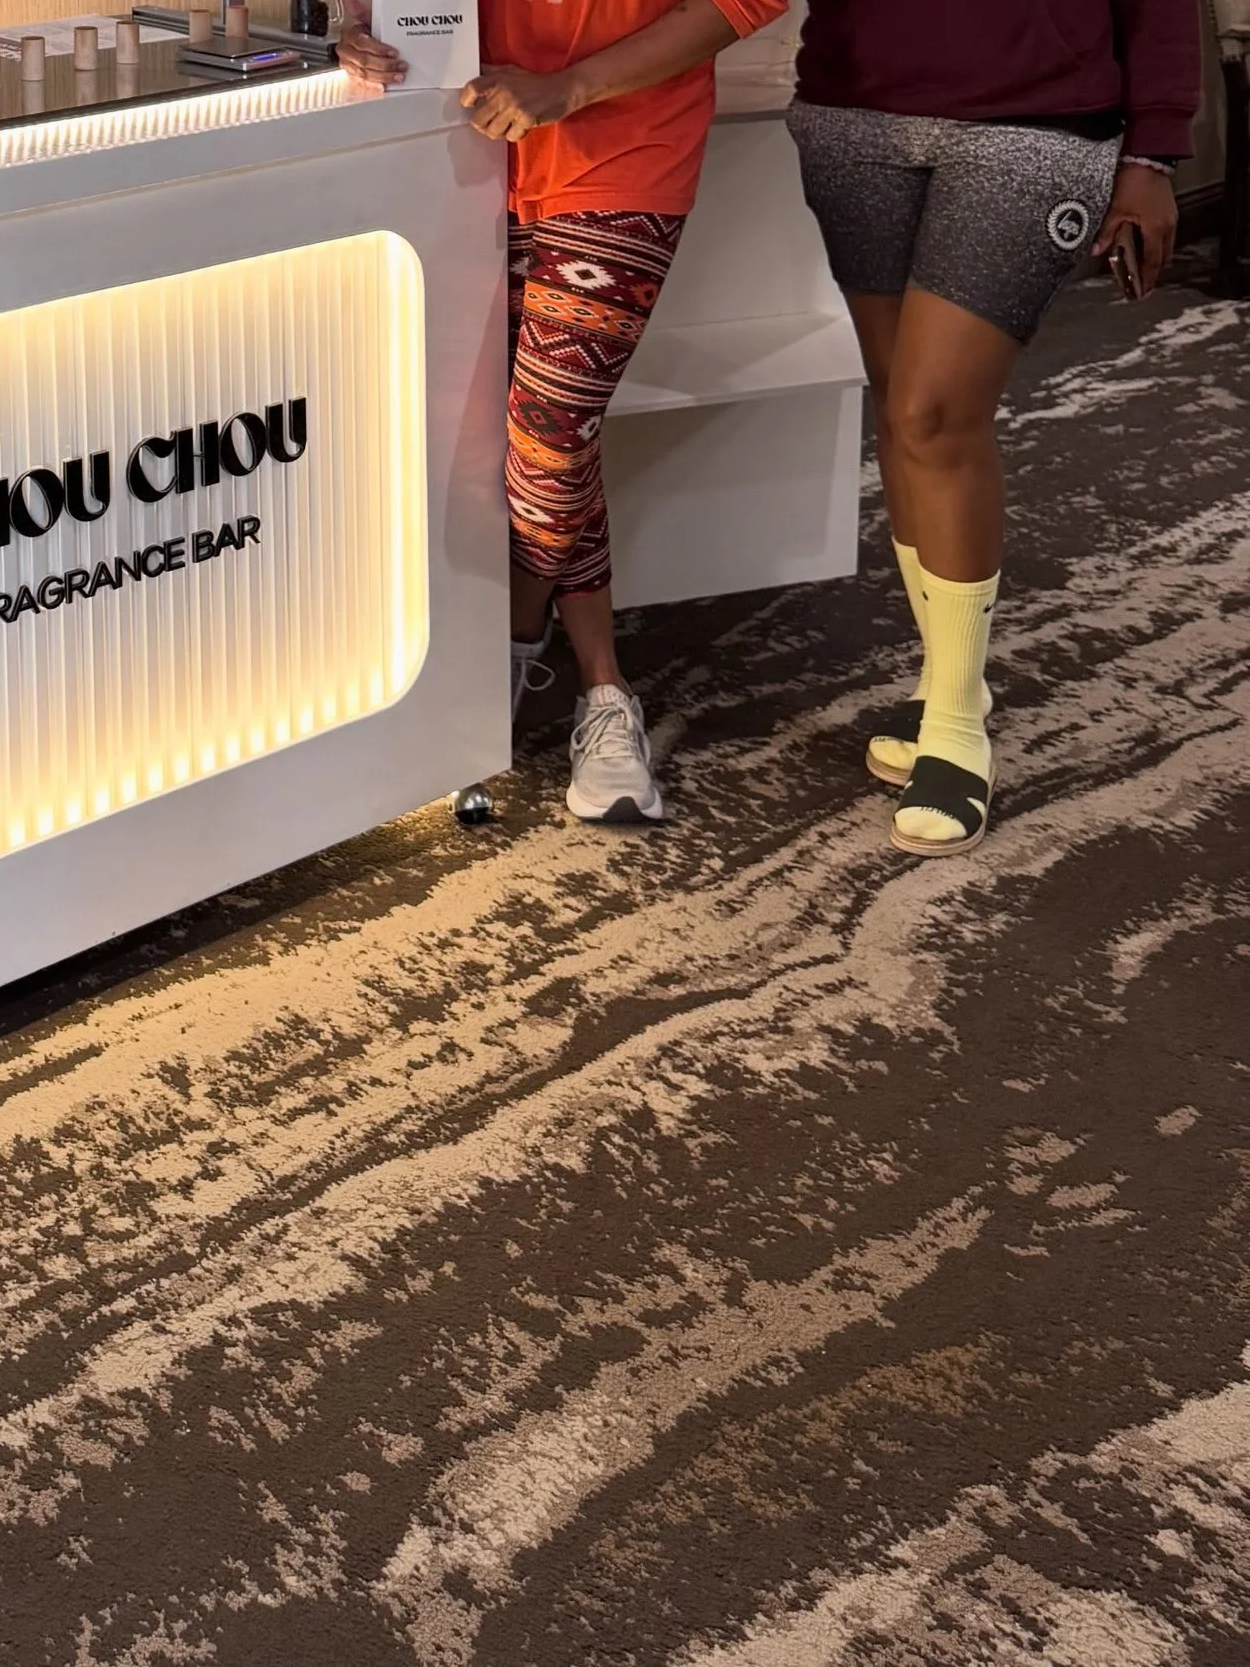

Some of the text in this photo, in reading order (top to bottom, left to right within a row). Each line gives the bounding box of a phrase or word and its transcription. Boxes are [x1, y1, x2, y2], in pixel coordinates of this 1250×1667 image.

[397, 14, 462, 26] CHOU CHOU
[126, 396, 308, 504] CHOU
[191, 514, 262, 564] BAR
